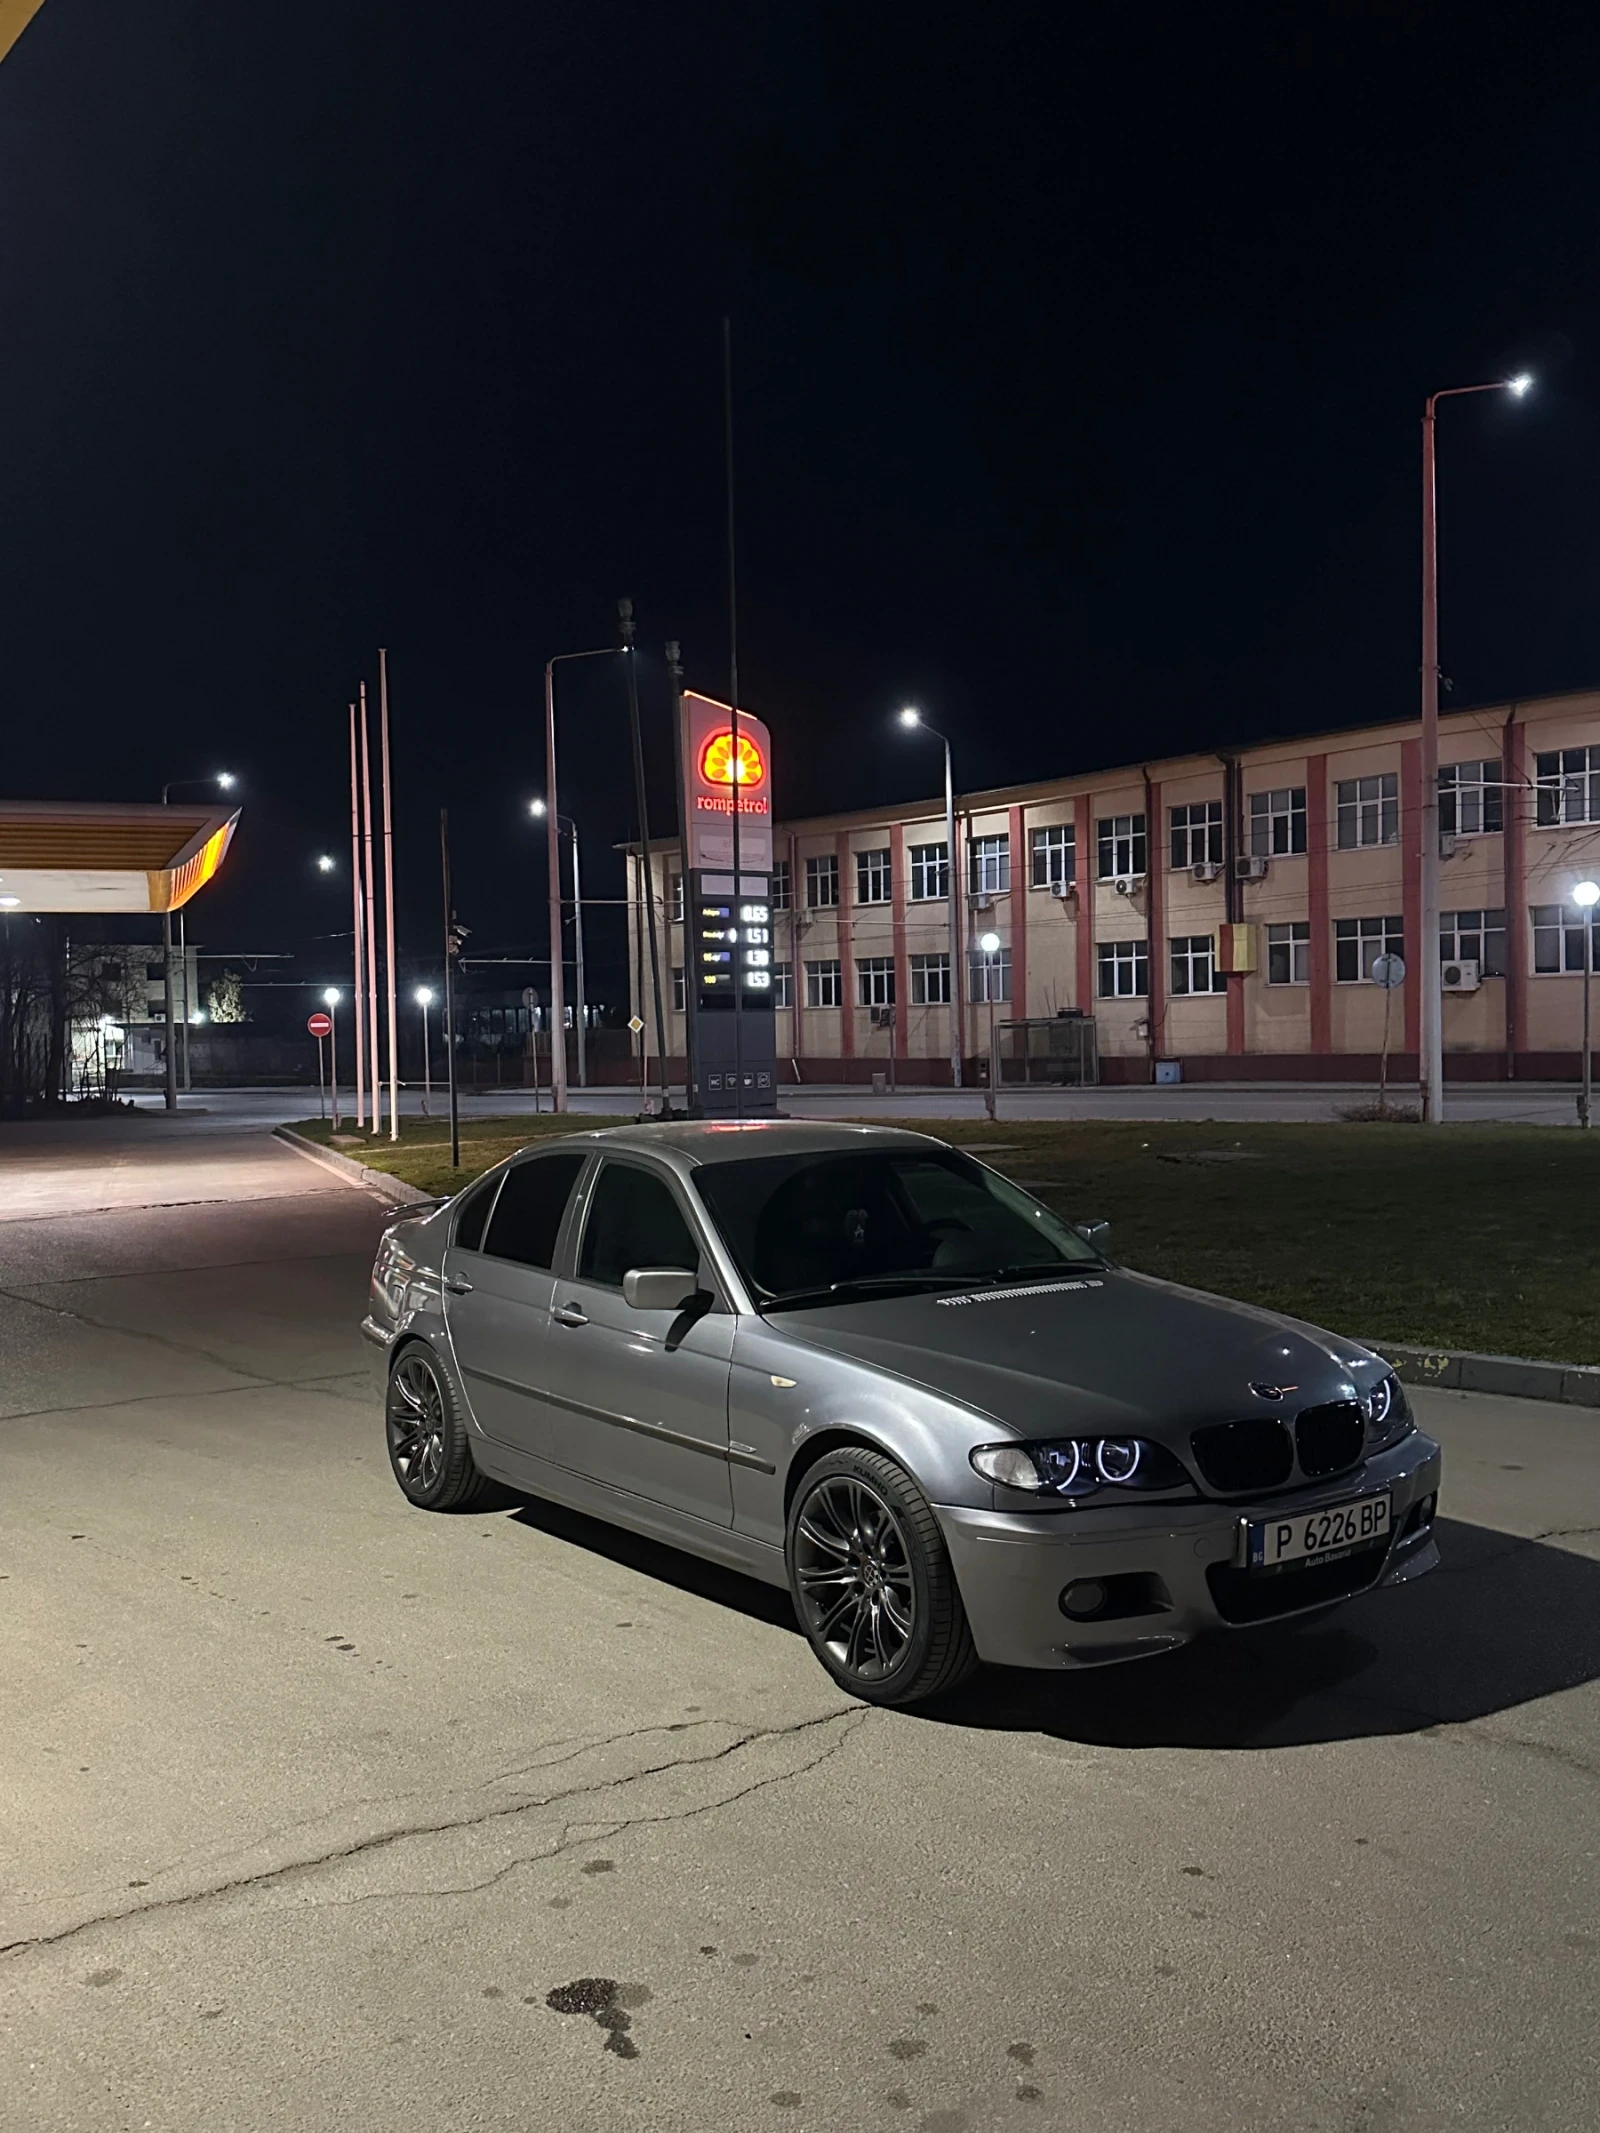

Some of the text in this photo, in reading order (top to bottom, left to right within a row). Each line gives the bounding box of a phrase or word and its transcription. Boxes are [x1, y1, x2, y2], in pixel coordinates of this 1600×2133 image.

[697, 796, 768, 816] rompetrol
[853, 1465, 889, 1496] KUMHO
[1277, 1500, 1386, 1558] P 6226 BP
[1252, 1551, 1264, 1563] BG
[1305, 1556, 1324, 1568] Auto
